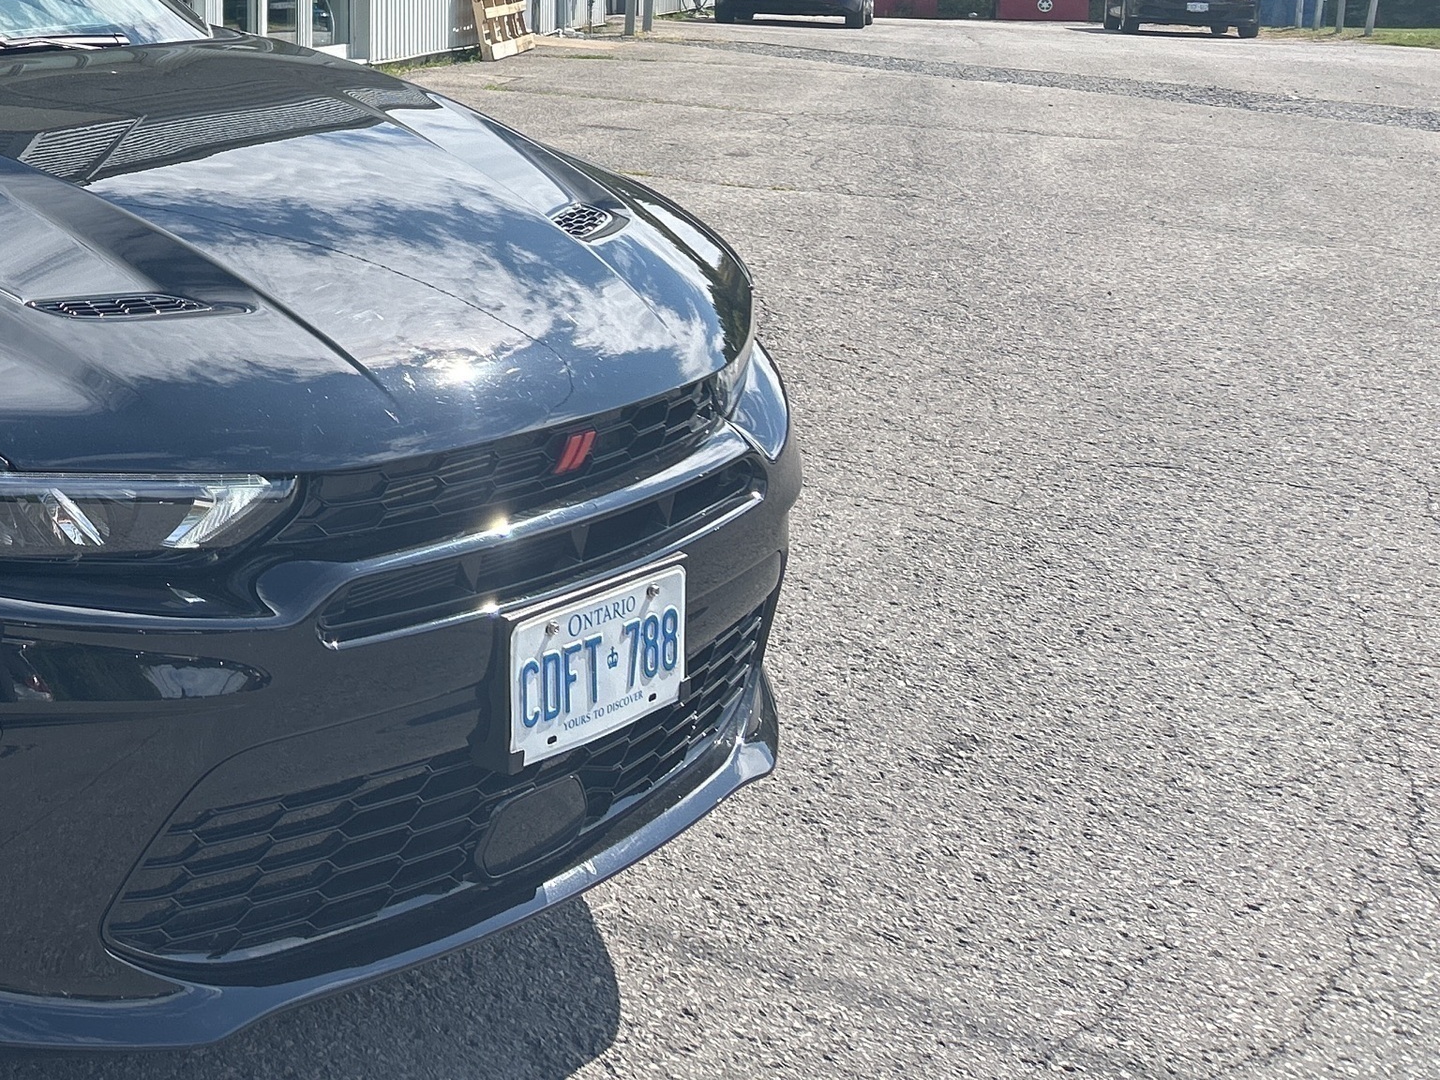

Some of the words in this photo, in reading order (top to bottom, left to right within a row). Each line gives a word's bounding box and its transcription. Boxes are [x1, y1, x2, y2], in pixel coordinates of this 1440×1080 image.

[568, 595, 636, 637] ONTARIO
[521, 634, 603, 728] CDFT
[625, 607, 679, 688] 788
[563, 712, 591, 731] YOURS
[593, 707, 605, 719] TO
[606, 690, 644, 714] DISCOVER
